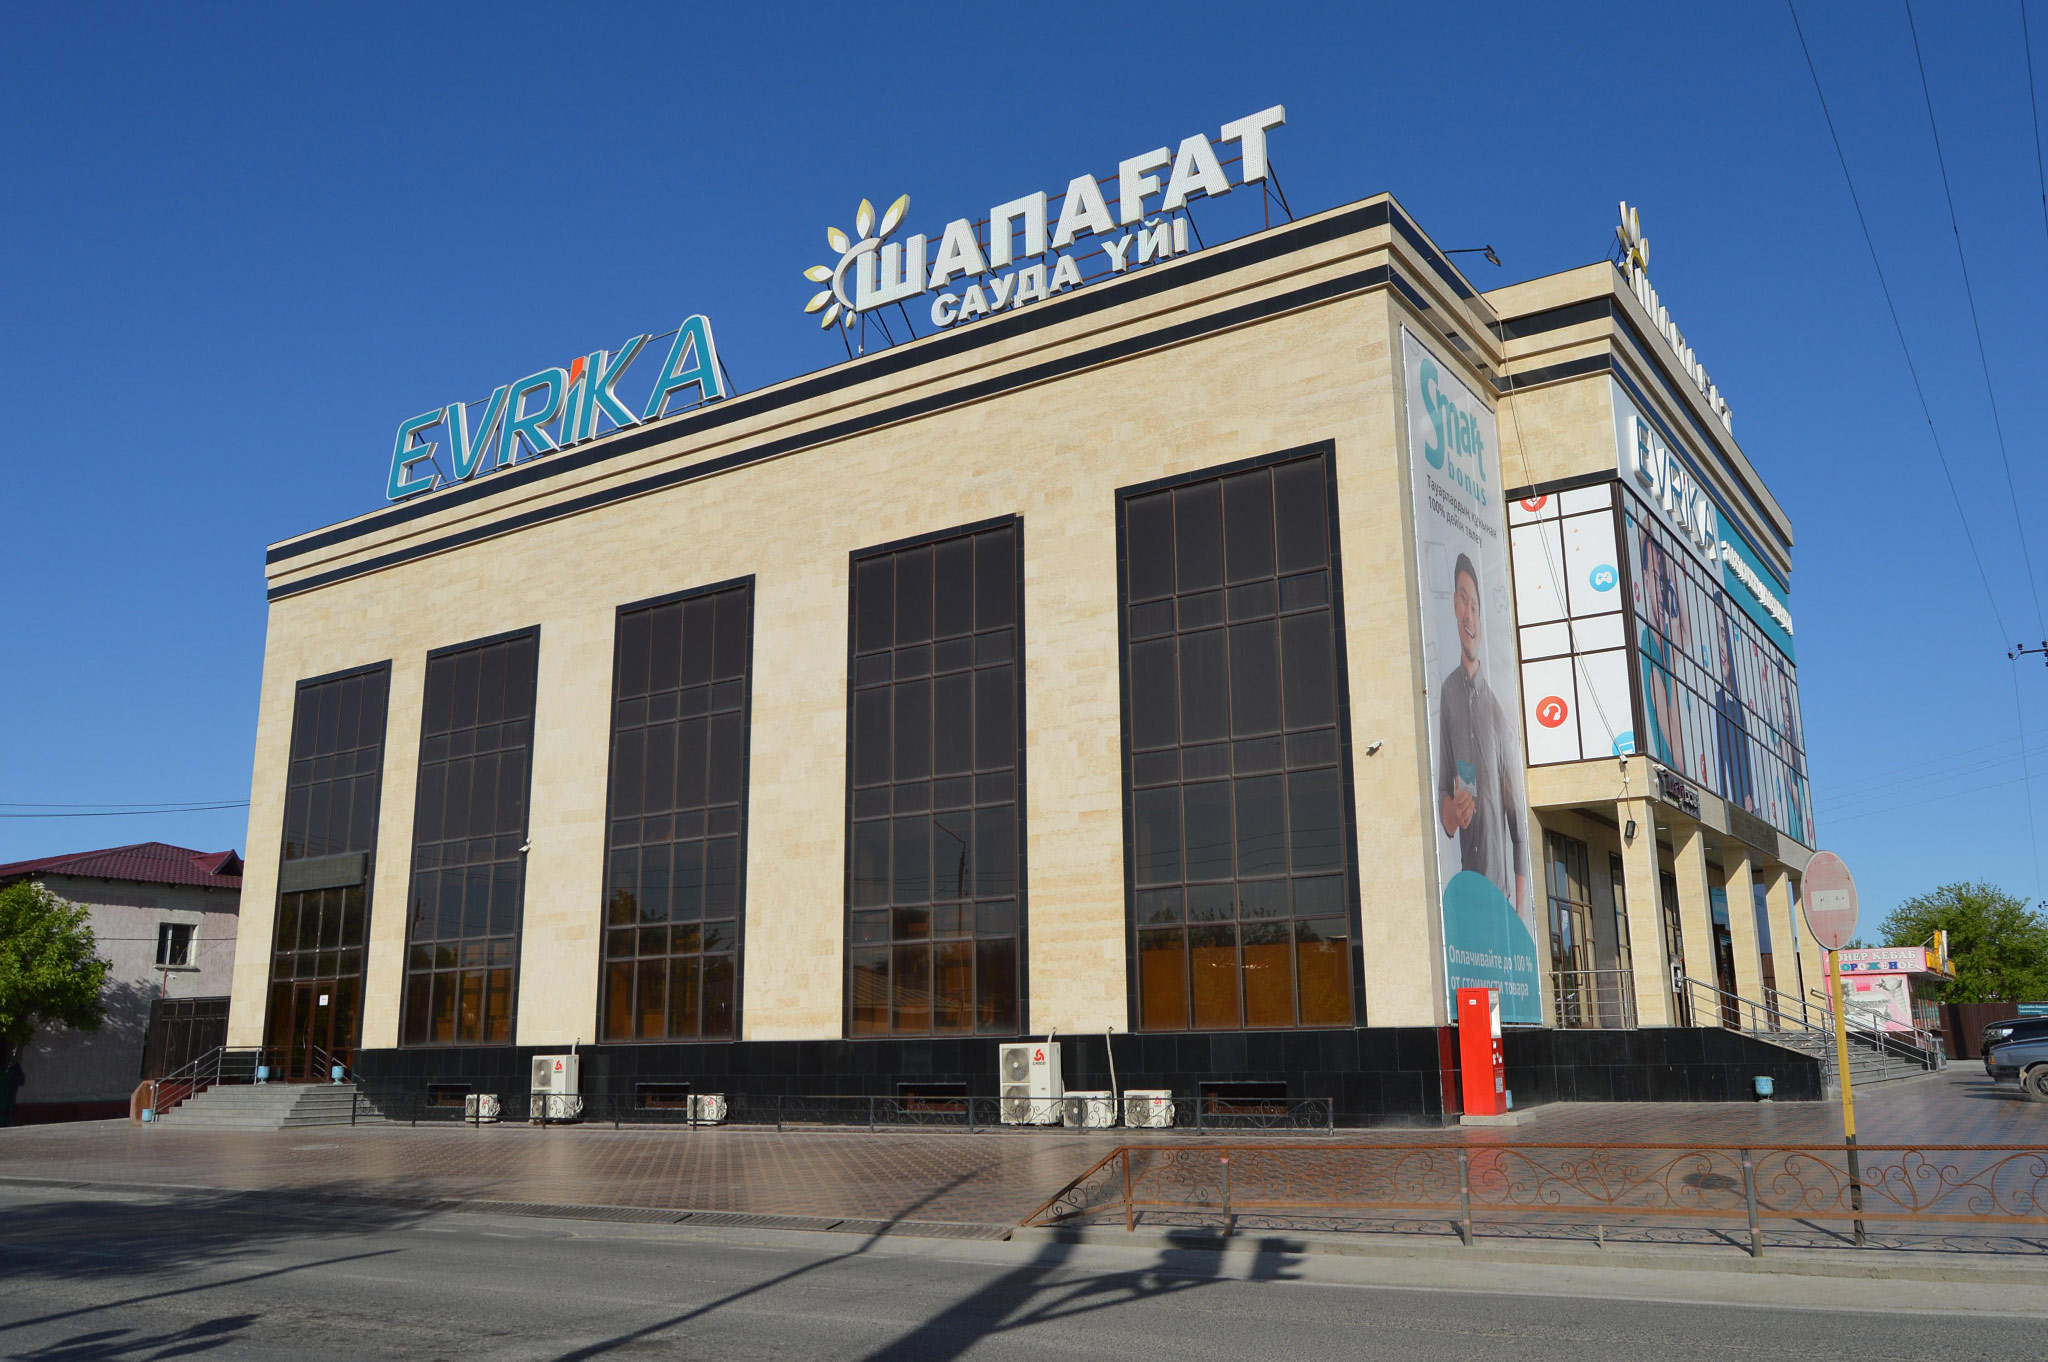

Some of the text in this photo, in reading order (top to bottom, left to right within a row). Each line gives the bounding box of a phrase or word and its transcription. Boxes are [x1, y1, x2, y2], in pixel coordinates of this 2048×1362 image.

[931, 254, 1084, 328] САУДА
[1420, 358, 1486, 482] Smart
[1447, 452, 1487, 507] bonus
[1428, 495, 1446, 518] 100%
[1449, 944, 1502, 969] Оплачивайте
[1503, 957, 1512, 973] до
[1514, 955, 1525, 972] 100
[1827, 950, 1916, 962] ОНЕР КЕБАБ
[1839, 961, 1916, 972] ОРОЖЕНОЕ
[1504, 982, 1529, 1000] товара
